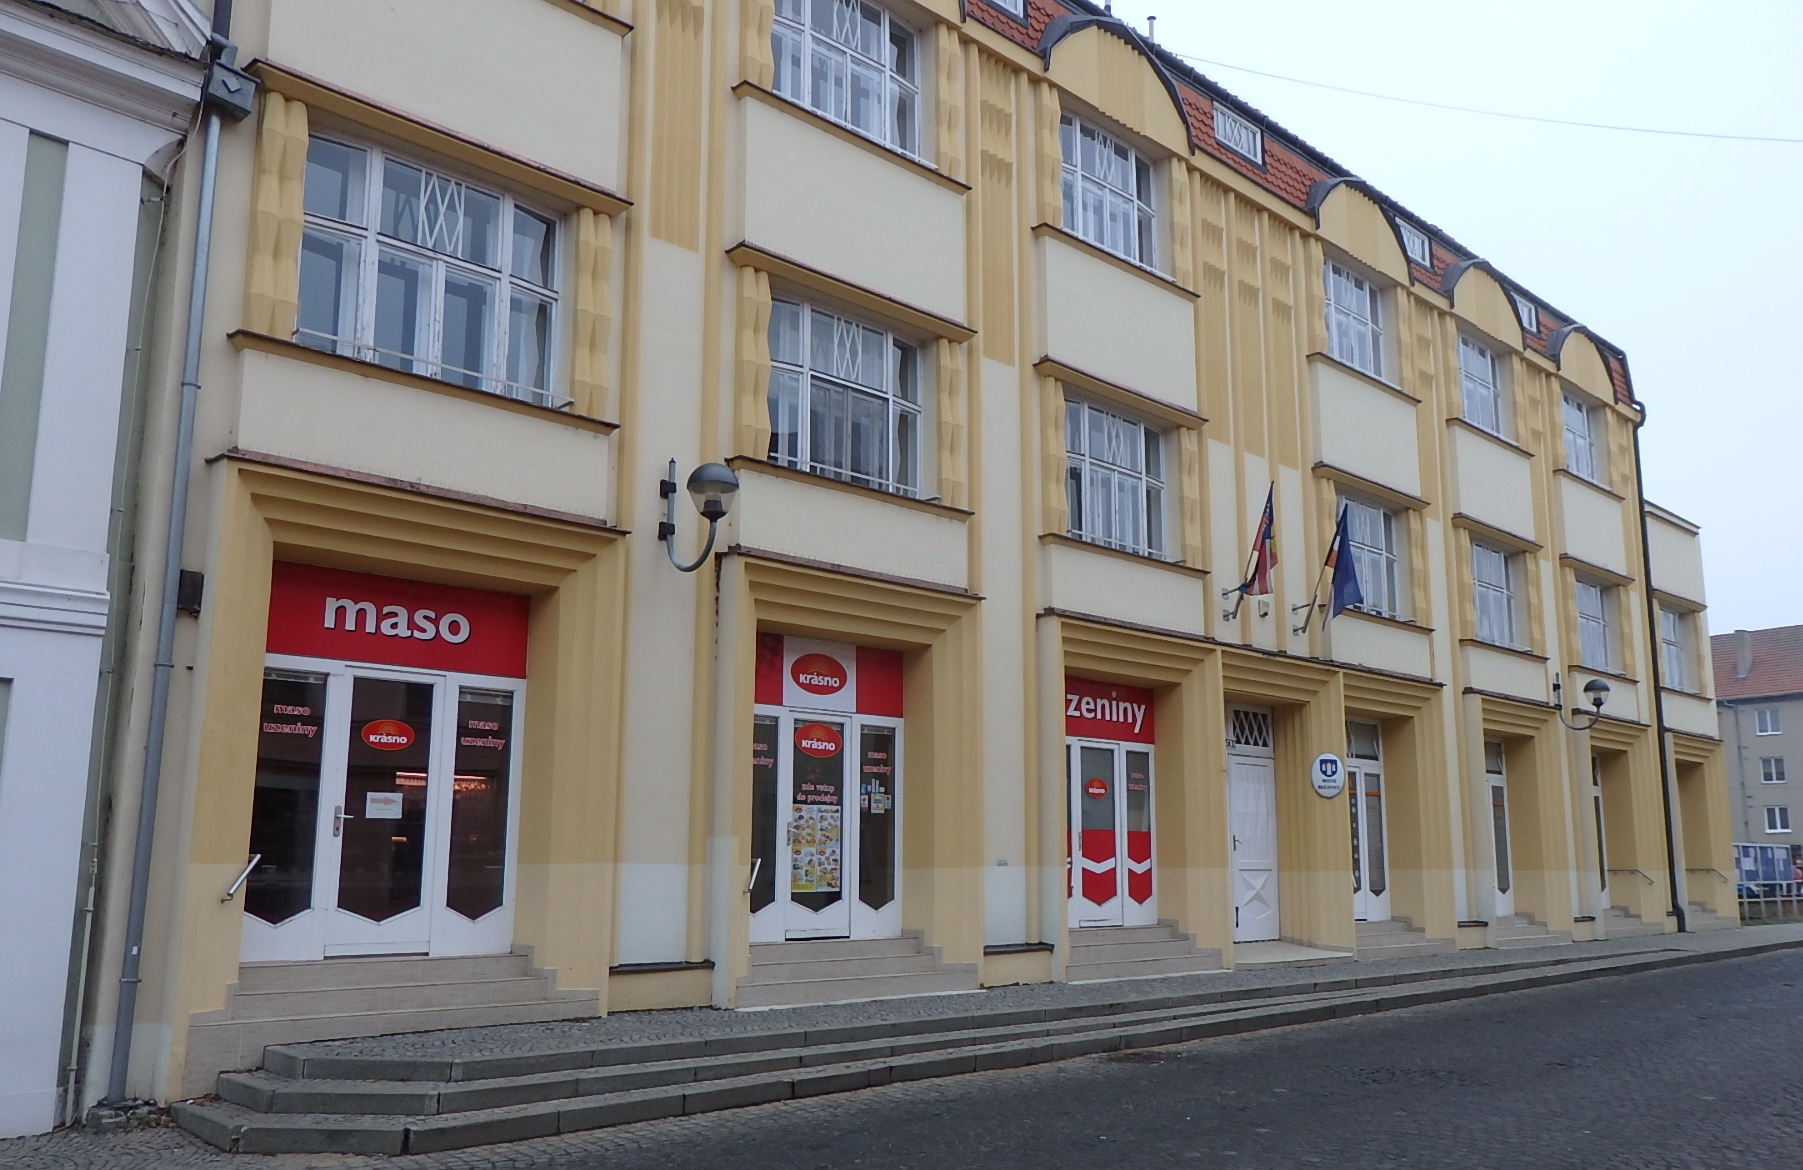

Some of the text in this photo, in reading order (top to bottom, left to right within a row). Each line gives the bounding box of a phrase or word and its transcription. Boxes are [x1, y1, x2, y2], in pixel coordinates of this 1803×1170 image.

[324, 597, 471, 644] maso
[274, 704, 311, 716] maso
[263, 722, 318, 738] uzeniny
[468, 720, 500, 731] maso
[461, 735, 506, 751] uzeniny
[796, 792, 807, 801] do
